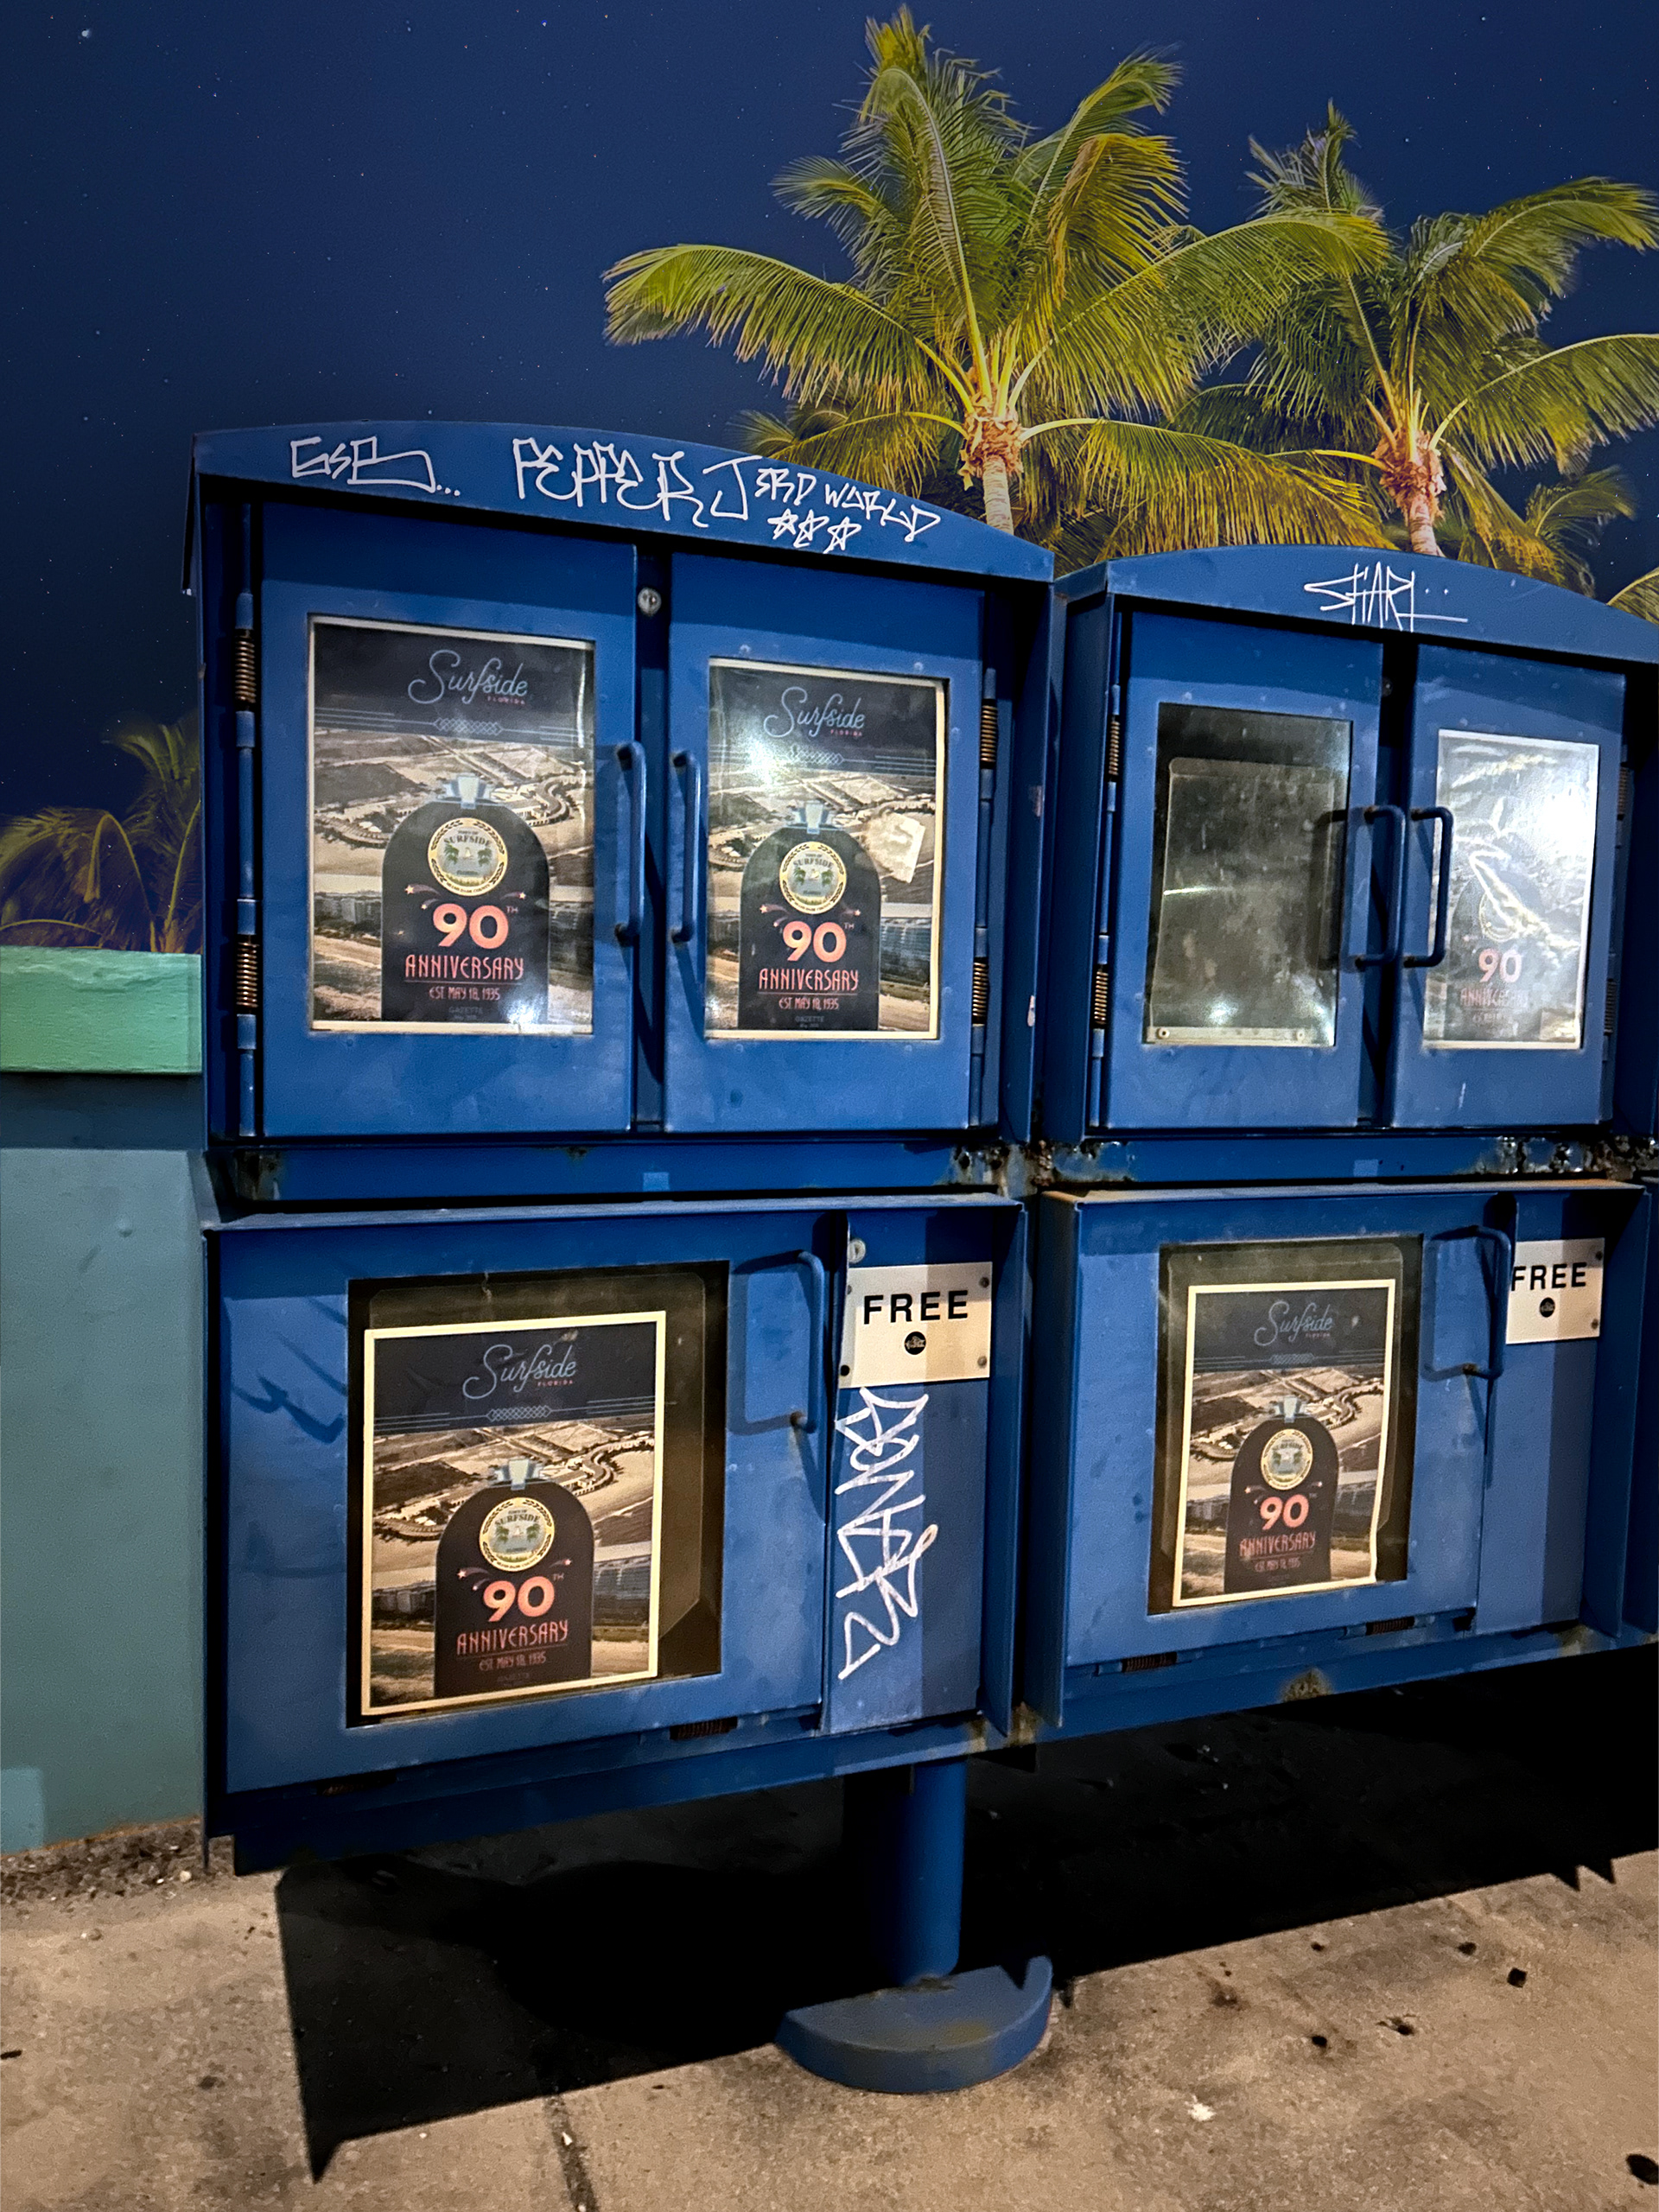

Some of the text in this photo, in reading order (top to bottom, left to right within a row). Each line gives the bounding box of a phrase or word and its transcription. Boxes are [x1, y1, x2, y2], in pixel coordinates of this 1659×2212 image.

[513, 437, 709, 527] PEPPER
[407, 649, 529, 705] Surfside
[763, 686, 866, 738] Surfside
[444, 835, 493, 847] SURFSIDE
[405, 954, 524, 981] ANNIVERSARY
[759, 968, 859, 992] ANNIVERSARY
[1478, 948, 1522, 983] 90
[448, 986, 467, 1000] MAY
[482, 987, 500, 1001] 1935
[1511, 1262, 1587, 1291] FREE
[864, 1290, 969, 1325] FREE
[1254, 1300, 1333, 1346] Surfside
[462, 1344, 576, 1400] Surfside
[495, 1513, 541, 1525] SURFSIDE
[1239, 1530, 1316, 1557] ANNIVERSARY
[456, 1619, 569, 1655] ANNIVERSARY
